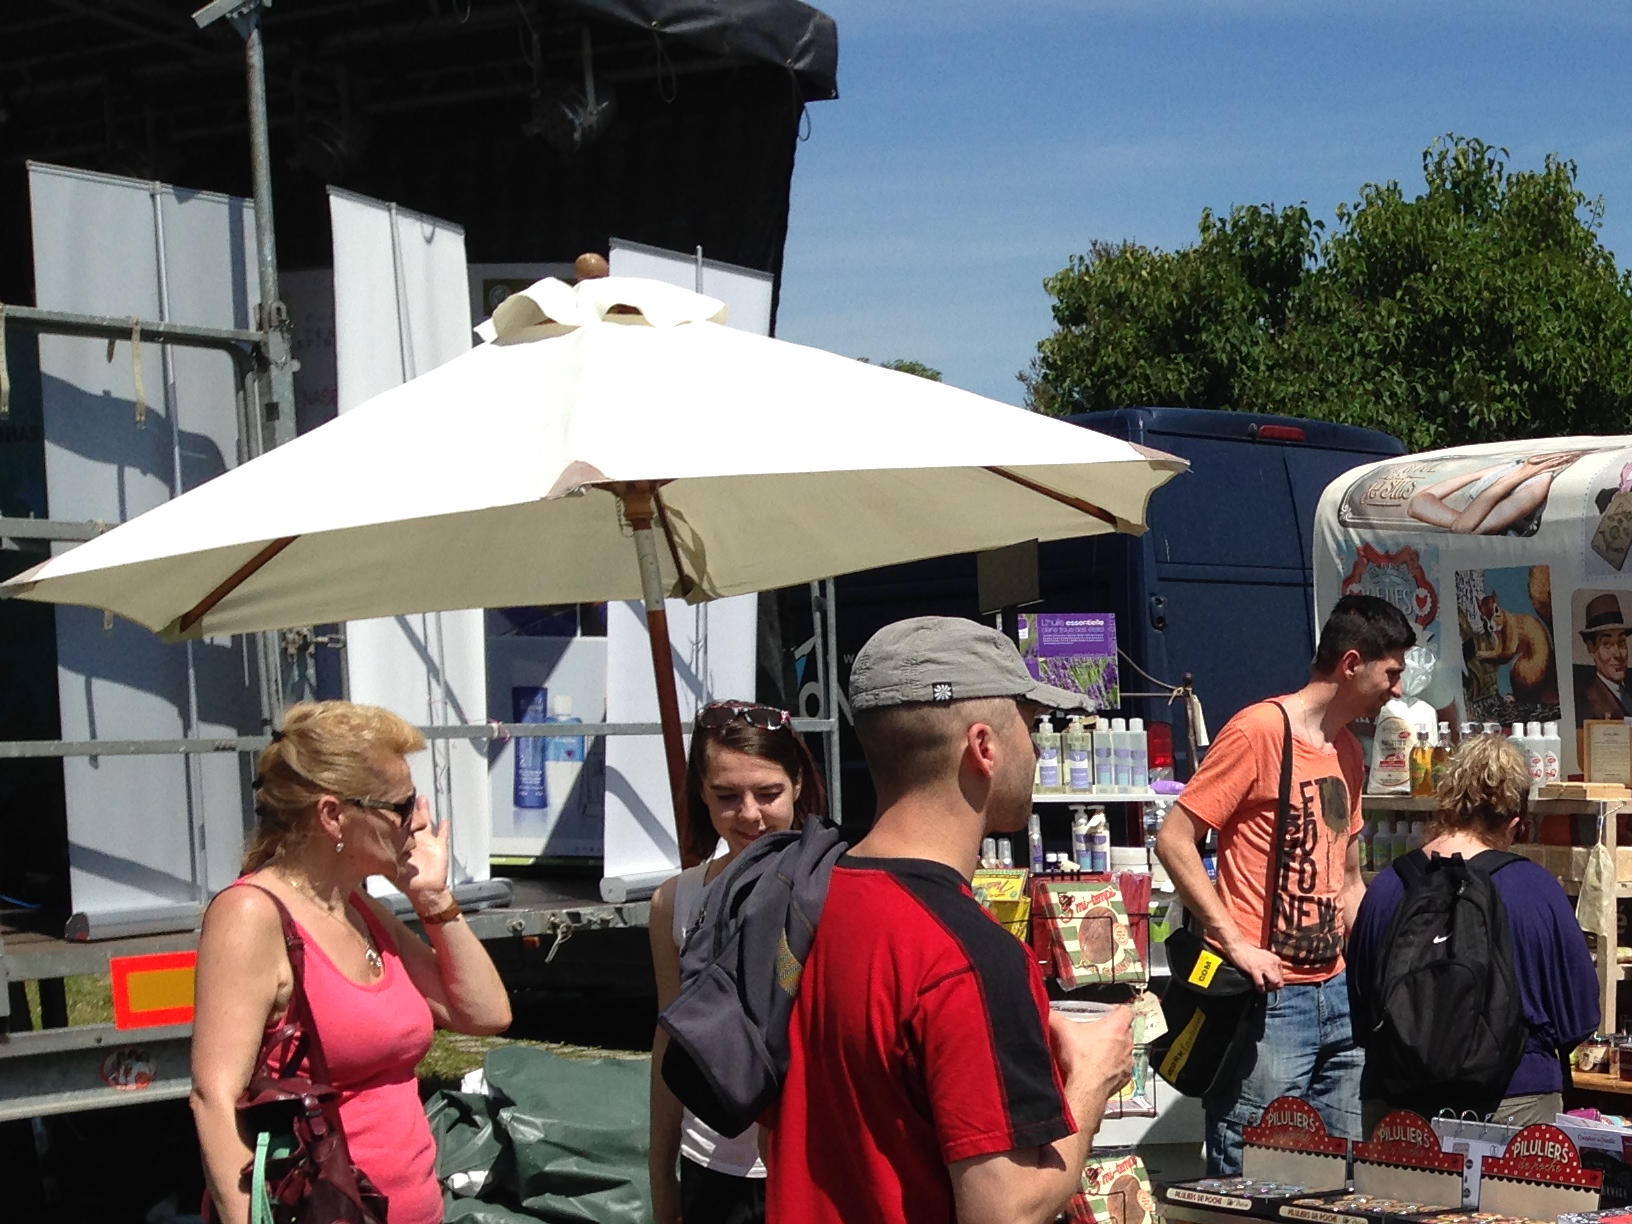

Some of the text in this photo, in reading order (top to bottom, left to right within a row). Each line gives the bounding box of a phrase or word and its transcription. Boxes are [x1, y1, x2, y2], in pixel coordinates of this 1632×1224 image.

[1267, 1110, 1317, 1133] PILULIERS
[1378, 1125, 1430, 1149] PILULIERS
[1512, 1139, 1571, 1164] PILULIERS
